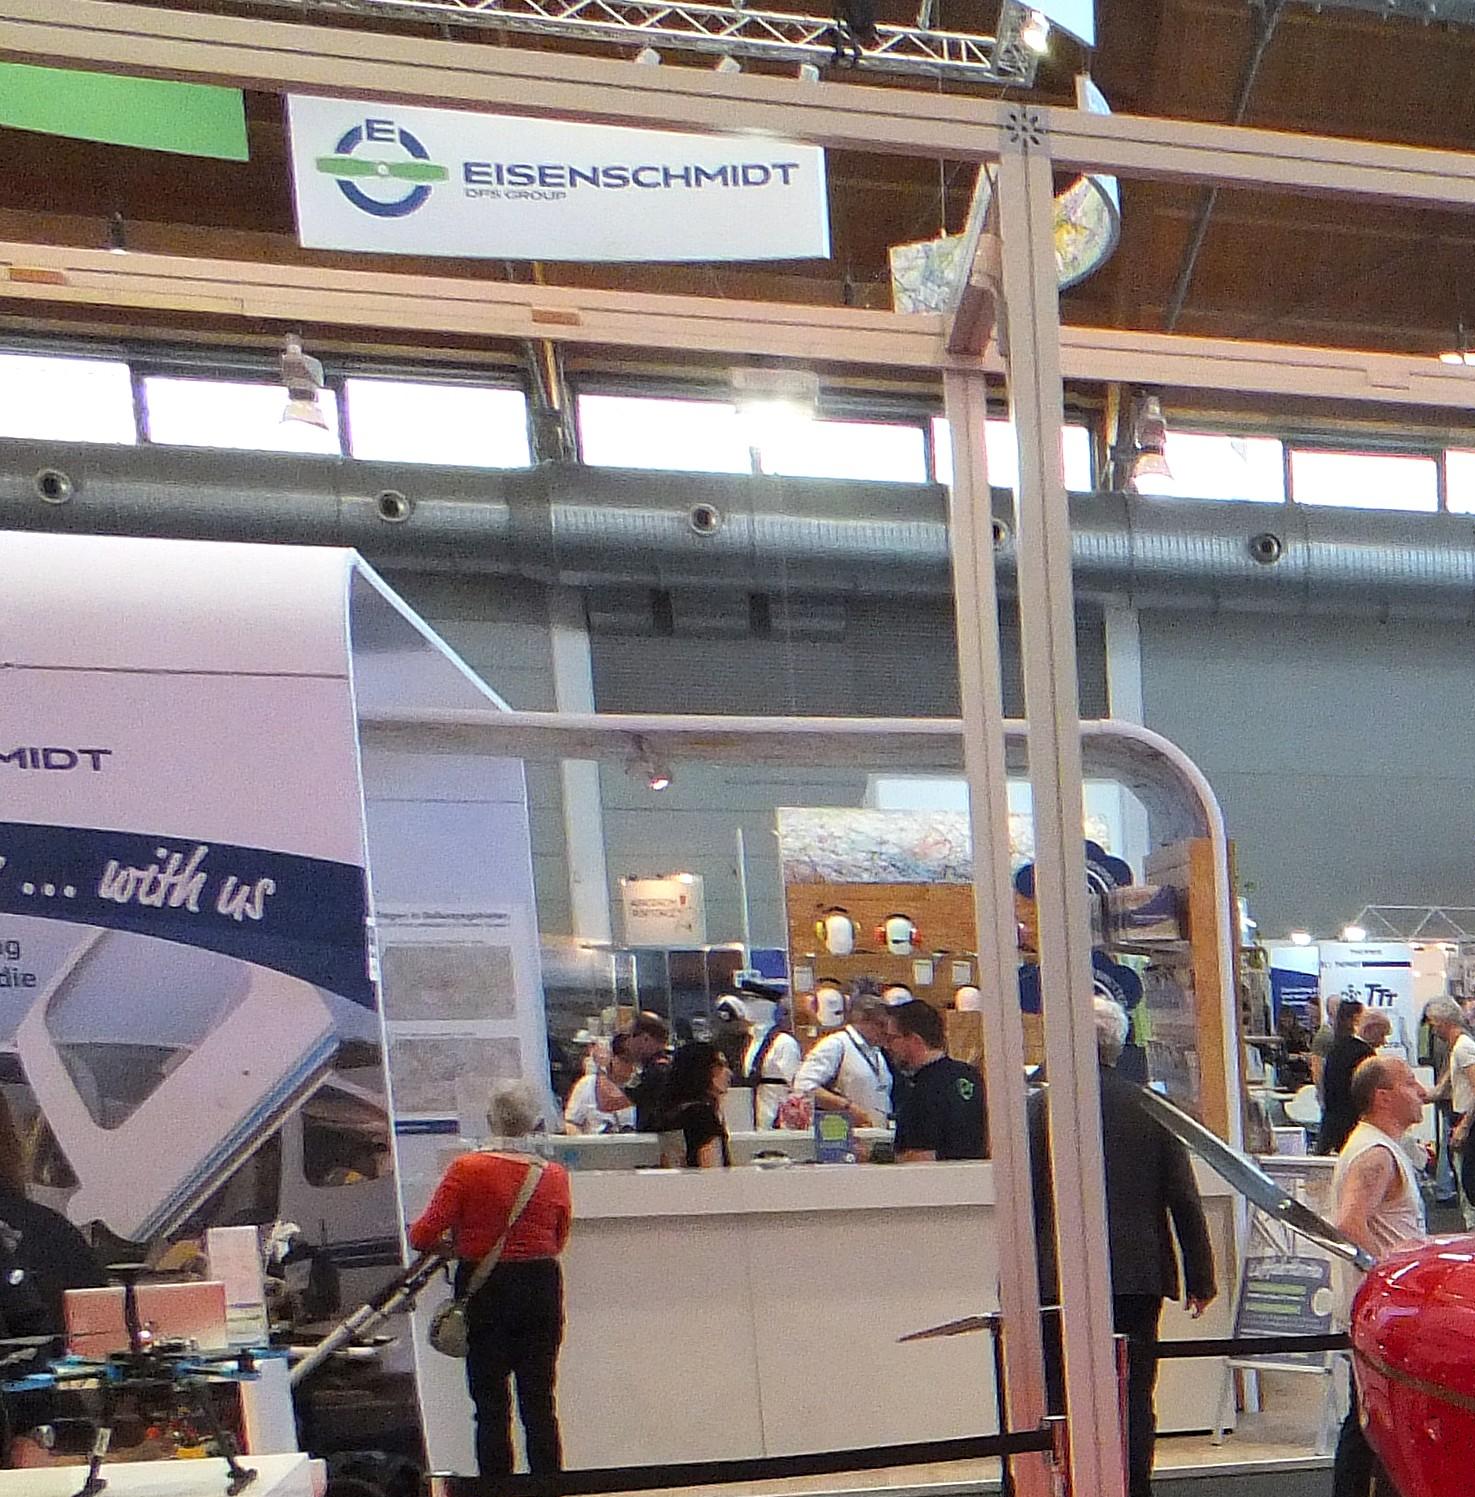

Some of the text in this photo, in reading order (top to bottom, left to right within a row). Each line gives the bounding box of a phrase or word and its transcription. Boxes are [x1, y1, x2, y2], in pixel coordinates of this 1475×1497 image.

[365, 118, 396, 142] E
[464, 161, 799, 188] EISENSCHMIDT
[504, 191, 566, 202] GROUP
[98, 845, 208, 912] with
[217, 876, 276, 921] us
